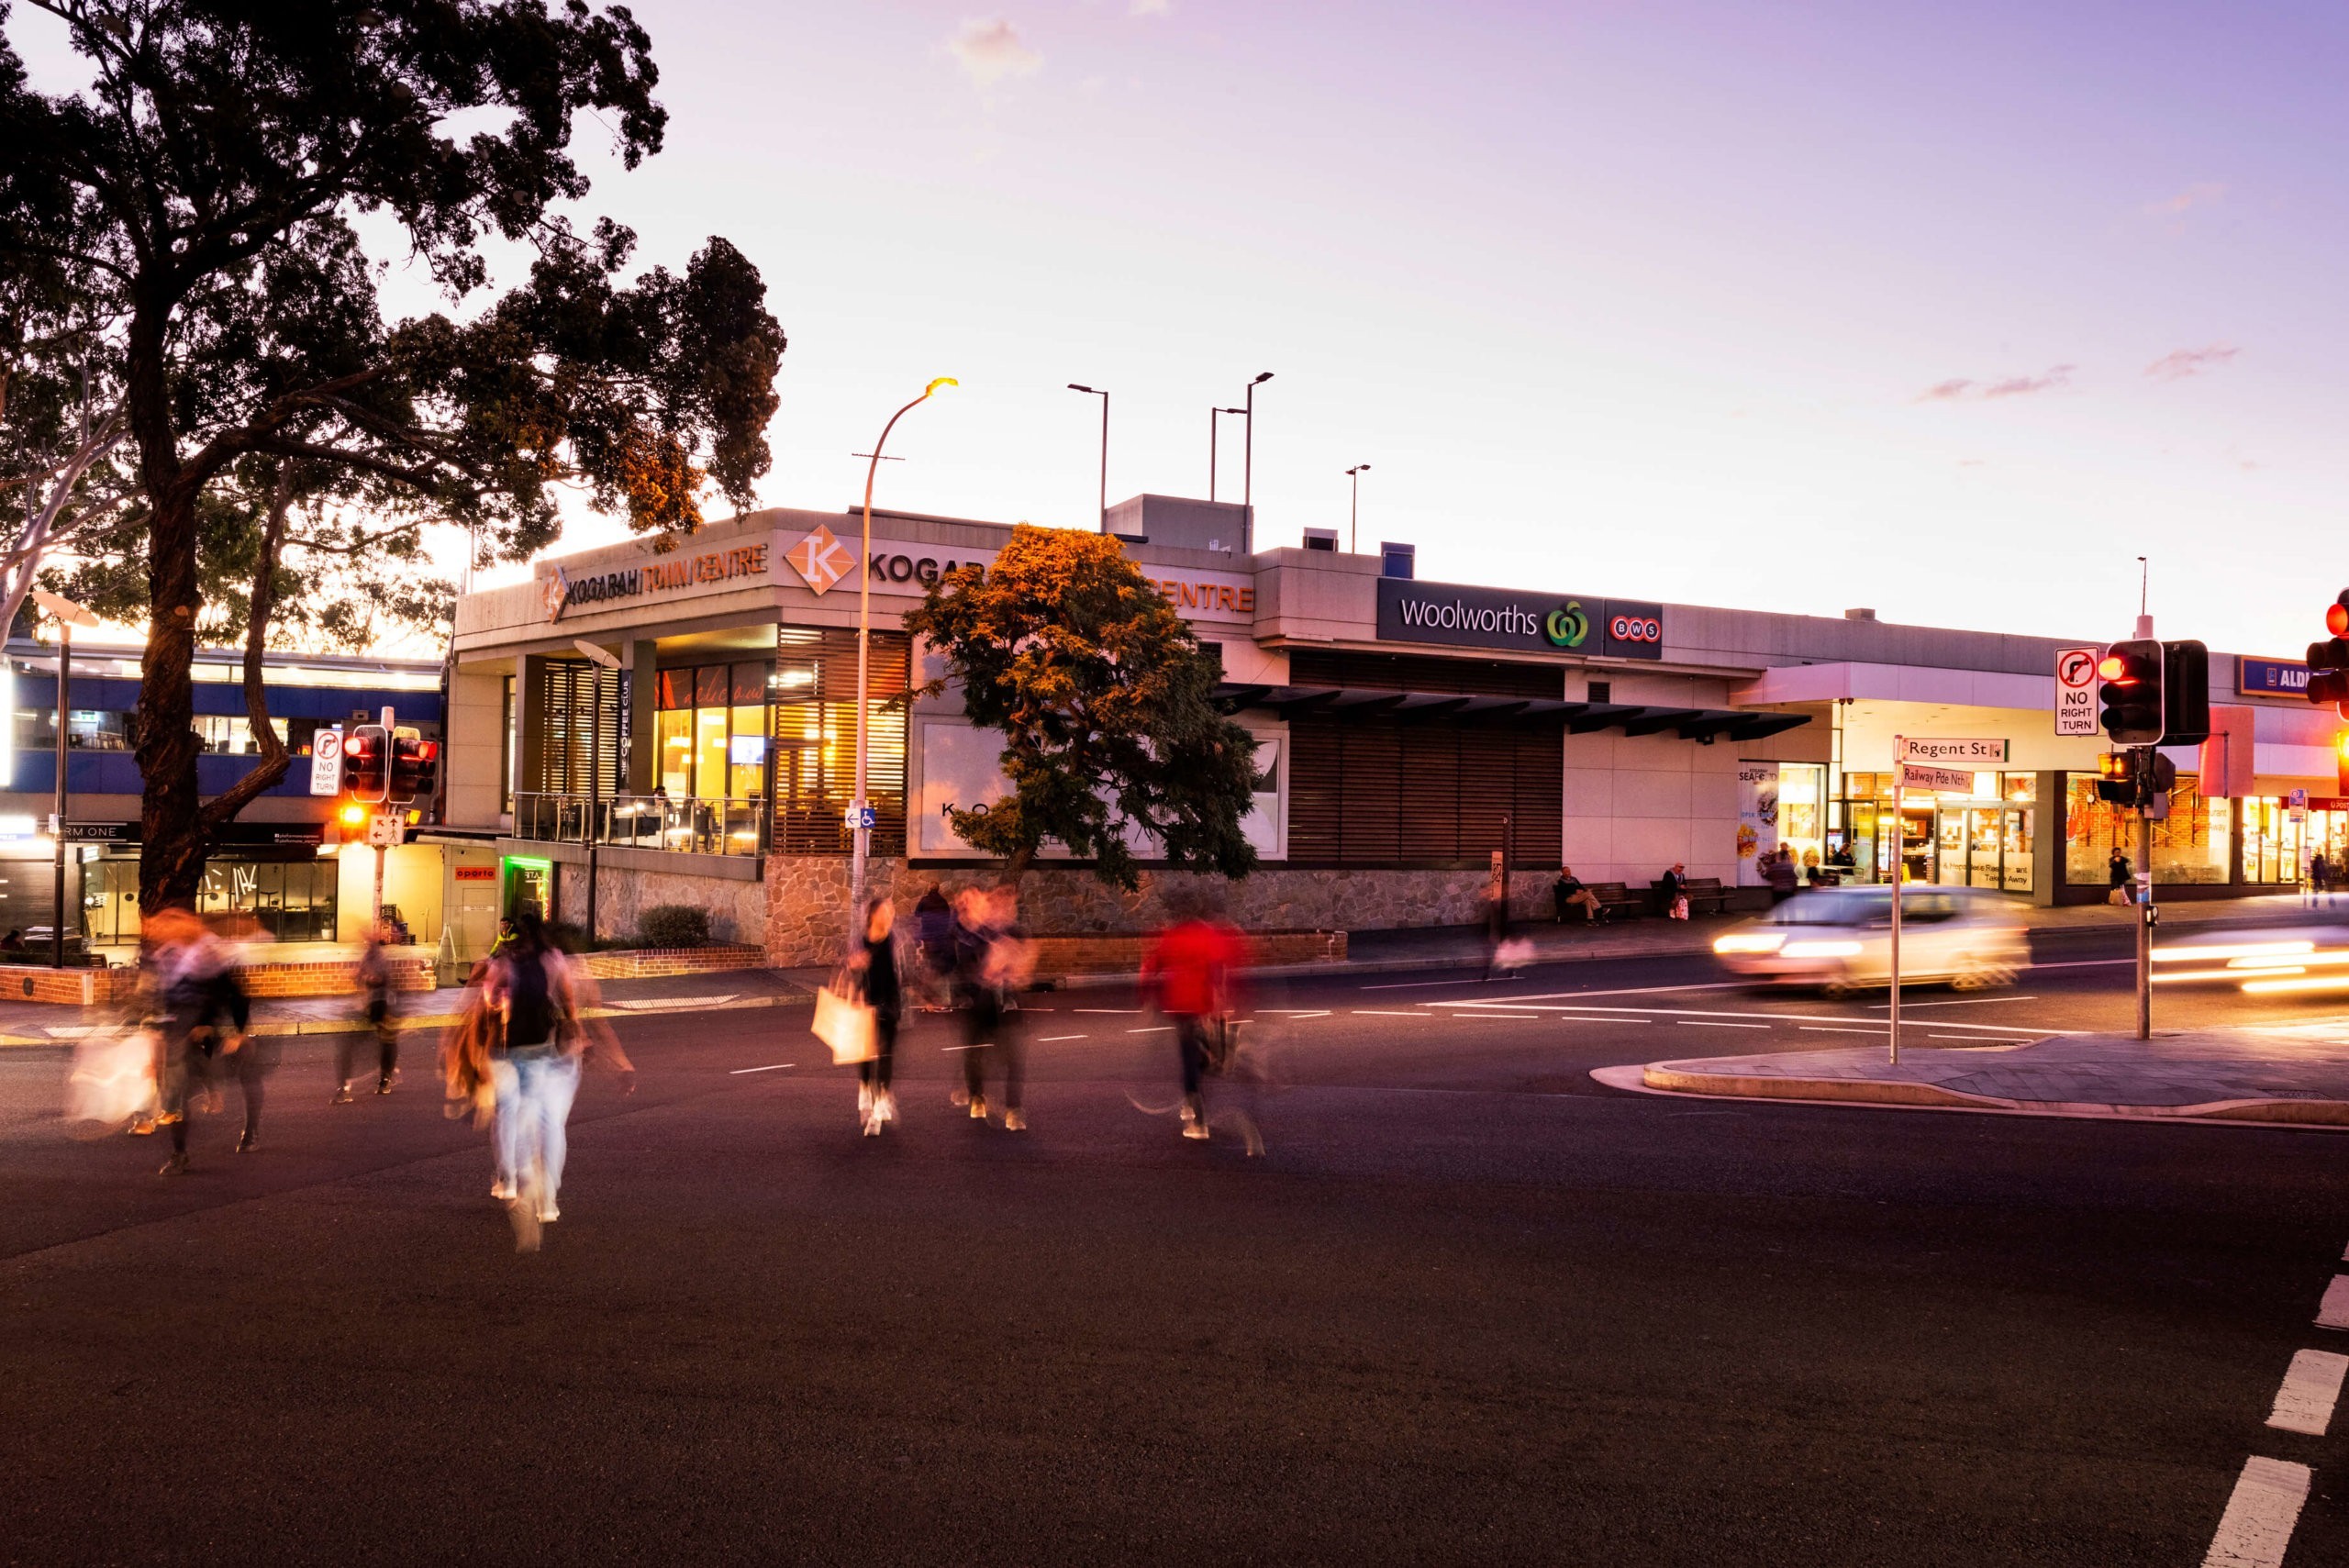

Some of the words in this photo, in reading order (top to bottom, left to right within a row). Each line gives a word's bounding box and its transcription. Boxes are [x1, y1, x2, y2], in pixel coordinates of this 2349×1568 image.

[869, 552, 985, 584] KOGAR
[568, 570, 639, 605] KOGARAH
[641, 559, 689, 592] TOWN
[693, 544, 767, 583] CENTRE
[1401, 599, 1538, 635] Woolworths
[2065, 692, 2087, 705] NO
[2061, 708, 2092, 717] RIGHT
[2062, 720, 2092, 729] TURN
[1909, 741, 1965, 758] Regent
[1971, 742, 1987, 755] St
[319, 762, 333, 772] NO
[1904, 768, 1934, 785] Railway
[1935, 772, 1949, 784] Pde
[1951, 773, 1965, 786] Nth
[87, 827, 117, 837] ONE
[457, 869, 495, 878] oporto
[2008, 875, 2027, 885] Away
